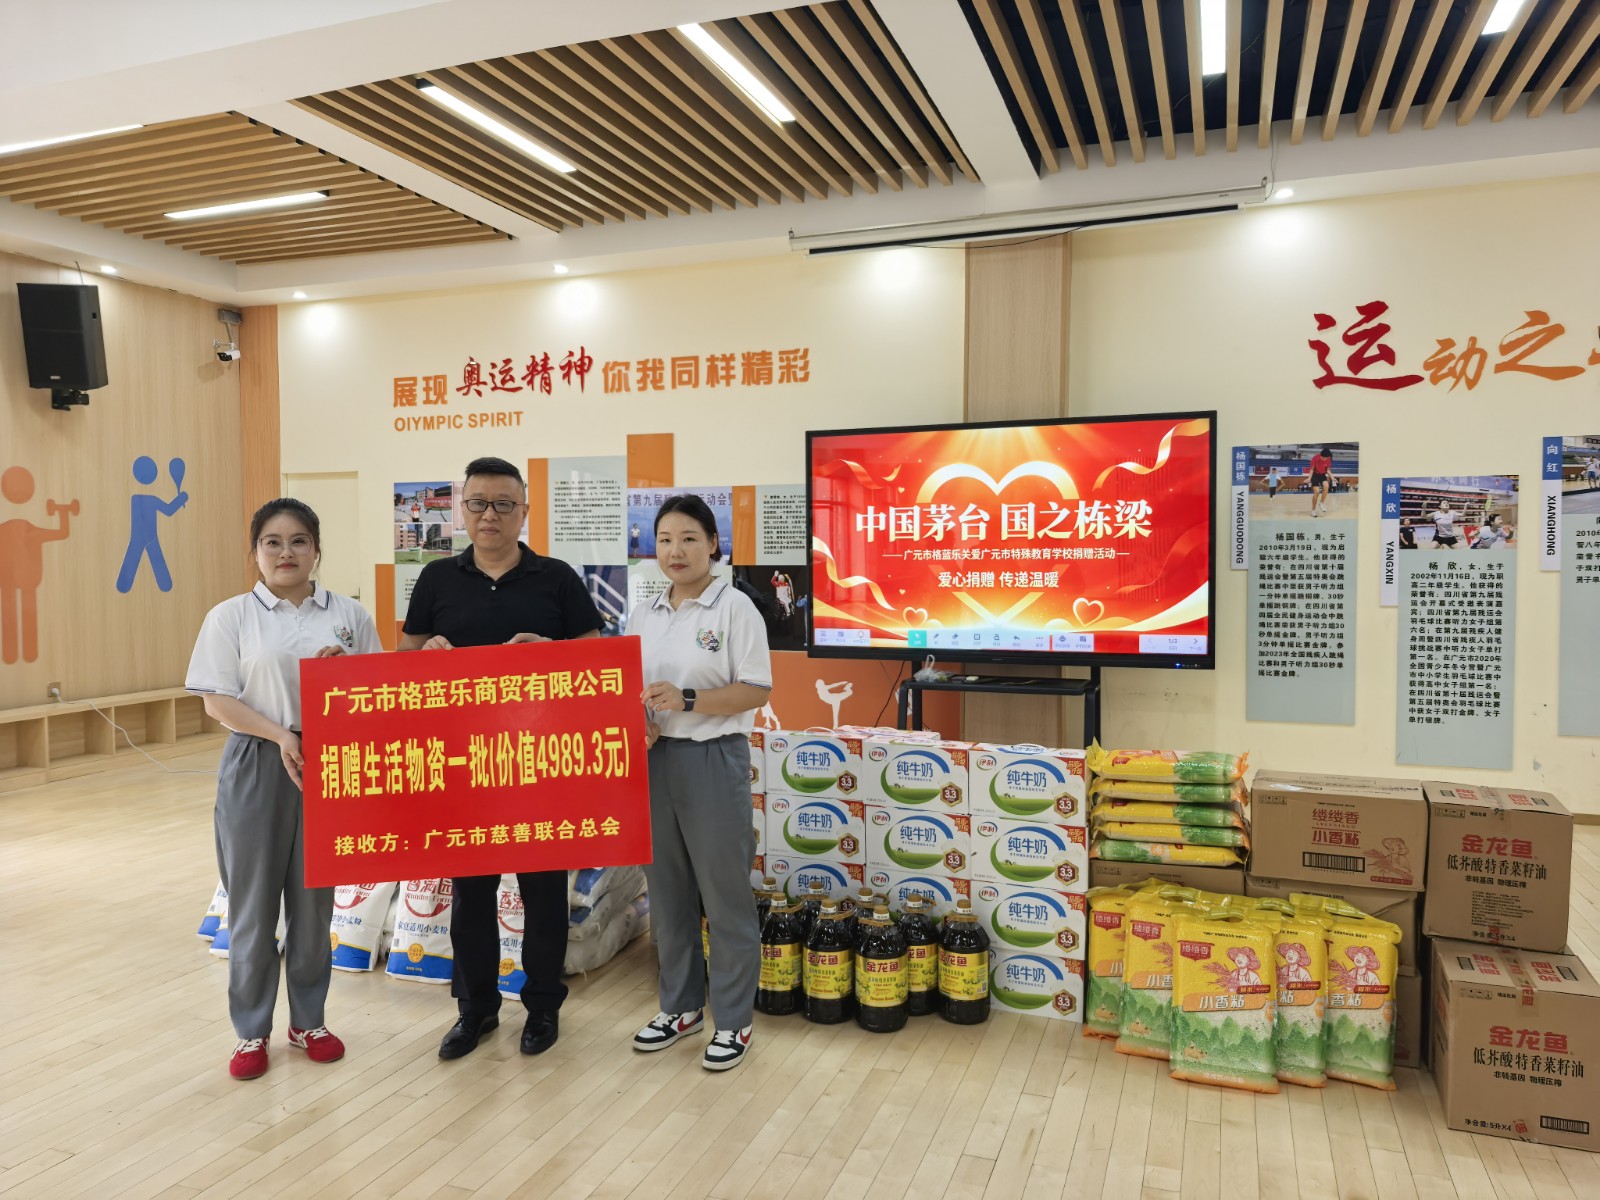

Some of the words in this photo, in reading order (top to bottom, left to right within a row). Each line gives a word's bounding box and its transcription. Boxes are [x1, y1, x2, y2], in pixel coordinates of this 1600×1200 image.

[1308, 300, 1600, 394] 运动之
[393, 375, 448, 408] 展现
[455, 346, 594, 398] 奥运精神
[602, 348, 811, 394] 你我同样精彩
[468, 410, 524, 428] SPIRIT
[1236, 451, 1246, 481] 杨国栋
[1546, 444, 1558, 472] 向红
[1386, 484, 1397, 513] 杨欣
[855, 502, 990, 543] 中国茅台
[1000, 499, 1153, 541] 国之栋梁
[1236, 491, 1244, 564] YANGGUODONG
[1546, 496, 1556, 556] XIANGHONG
[903, 548, 1116, 561] 广元市格蓝乐关爱广元市特殊教育学校捐赠活动
[1385, 541, 1394, 585] YANGXIN
[938, 571, 994, 588] 爱心捐赠
[999, 570, 1060, 588] 传递温暖
[322, 667, 624, 716] 广元市格蓝乐商贸有限公司
[320, 726, 630, 799] 捐赠生活物资一批(价值4989.3元)
[796, 751, 831, 767] 纯牛奶
[979, 759, 994, 767] 伊利
[896, 760, 933, 778] 纯牛奶
[841, 777, 852, 787] 3.3
[1007, 769, 1047, 788] 纯牛奶
[945, 789, 957, 798] 3.3
[774, 802, 787, 810] 伊利
[1059, 800, 1072, 809] 3.3
[798, 812, 832, 829] 纯牛奶
[1312, 808, 1360, 824] 缕缕香
[900, 825, 937, 843] 纯牛奶
[979, 825, 995, 833] 伊利
[842, 840, 854, 849] 3.3
[1007, 836, 1048, 855] 纯牛奶
[1312, 830, 1360, 846] 小香粘
[1462, 834, 1532, 859] 金龙鱼
[774, 863, 787, 871] 伊利
[948, 855, 960, 865] 3.3
[1447, 854, 1547, 880] 低芥酸特香菜籽油
[873, 876, 887, 884] 伊利
[1060, 867, 1073, 877] 3.3
[980, 889, 996, 898] 伊利
[1008, 902, 1048, 921] 纯牛奶
[397, 921, 448, 934] 家庭适用小麦粉
[1060, 934, 1073, 944] 3.3
[808, 952, 839, 965] 金龙鱼
[866, 961, 899, 972] 金龙鱼
[940, 951, 967, 966] 金龙鱼
[1006, 964, 1046, 984] 纯牛奶
[1057, 997, 1071, 1007] 3.3
[1200, 995, 1245, 1009] 小香粘
[1489, 1025, 1568, 1055] 金龙鱼
[1473, 1047, 1584, 1078] 低芥酸特香菜籽油
[1494, 1070, 1526, 1082] 非转基因
[1529, 1075, 1562, 1087] 物理压榨
